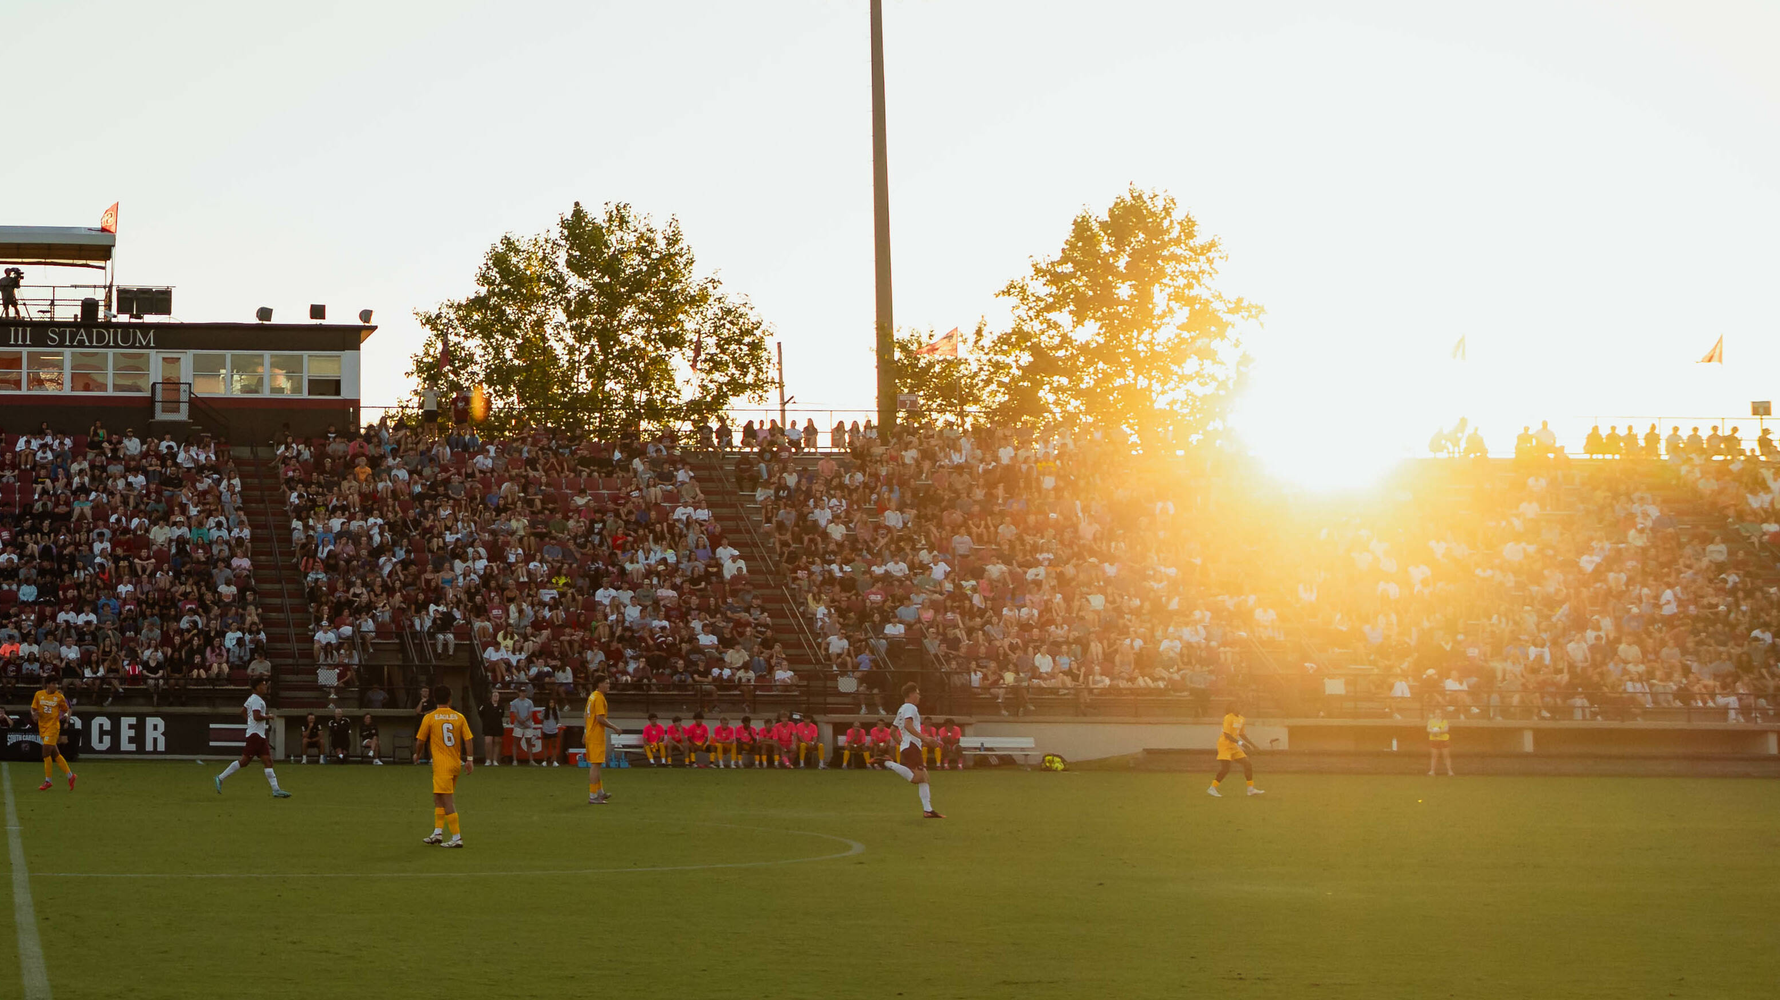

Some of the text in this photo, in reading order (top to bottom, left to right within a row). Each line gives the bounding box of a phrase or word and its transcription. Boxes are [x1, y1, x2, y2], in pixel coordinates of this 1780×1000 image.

[8, 326, 32, 344] III
[46, 327, 156, 347] STADIUM
[7, 734, 22, 746] SOUTH
[441, 722, 456, 747] 6
